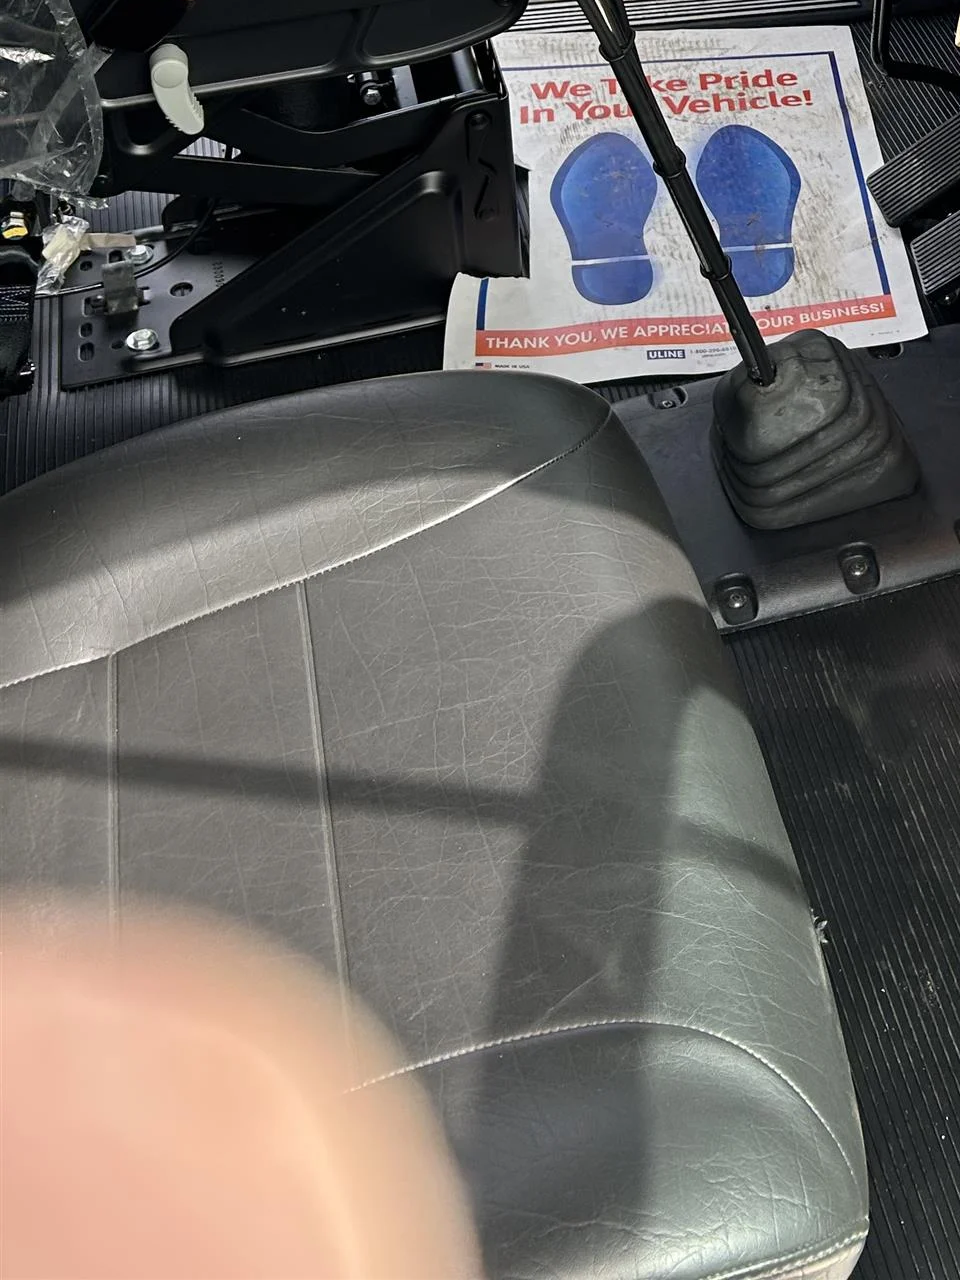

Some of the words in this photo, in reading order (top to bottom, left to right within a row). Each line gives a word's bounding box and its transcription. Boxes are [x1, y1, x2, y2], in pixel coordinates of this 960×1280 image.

[531, 80, 592, 100] We
[600, 74, 688, 95] Tke
[699, 68, 798, 91] Pride
[520, 105, 555, 124] In
[565, 100, 633, 120] You
[662, 90, 814, 115] Vehicle!
[486, 336, 550, 349] THANK
[554, 330, 597, 346] YOU,
[601, 326, 628, 340] WE
[633, 322, 731, 338] APPRECIAT
[757, 315, 794, 330] OUR
[800, 302, 885, 323] BUSINESS!
[648, 349, 685, 360] ULINE
